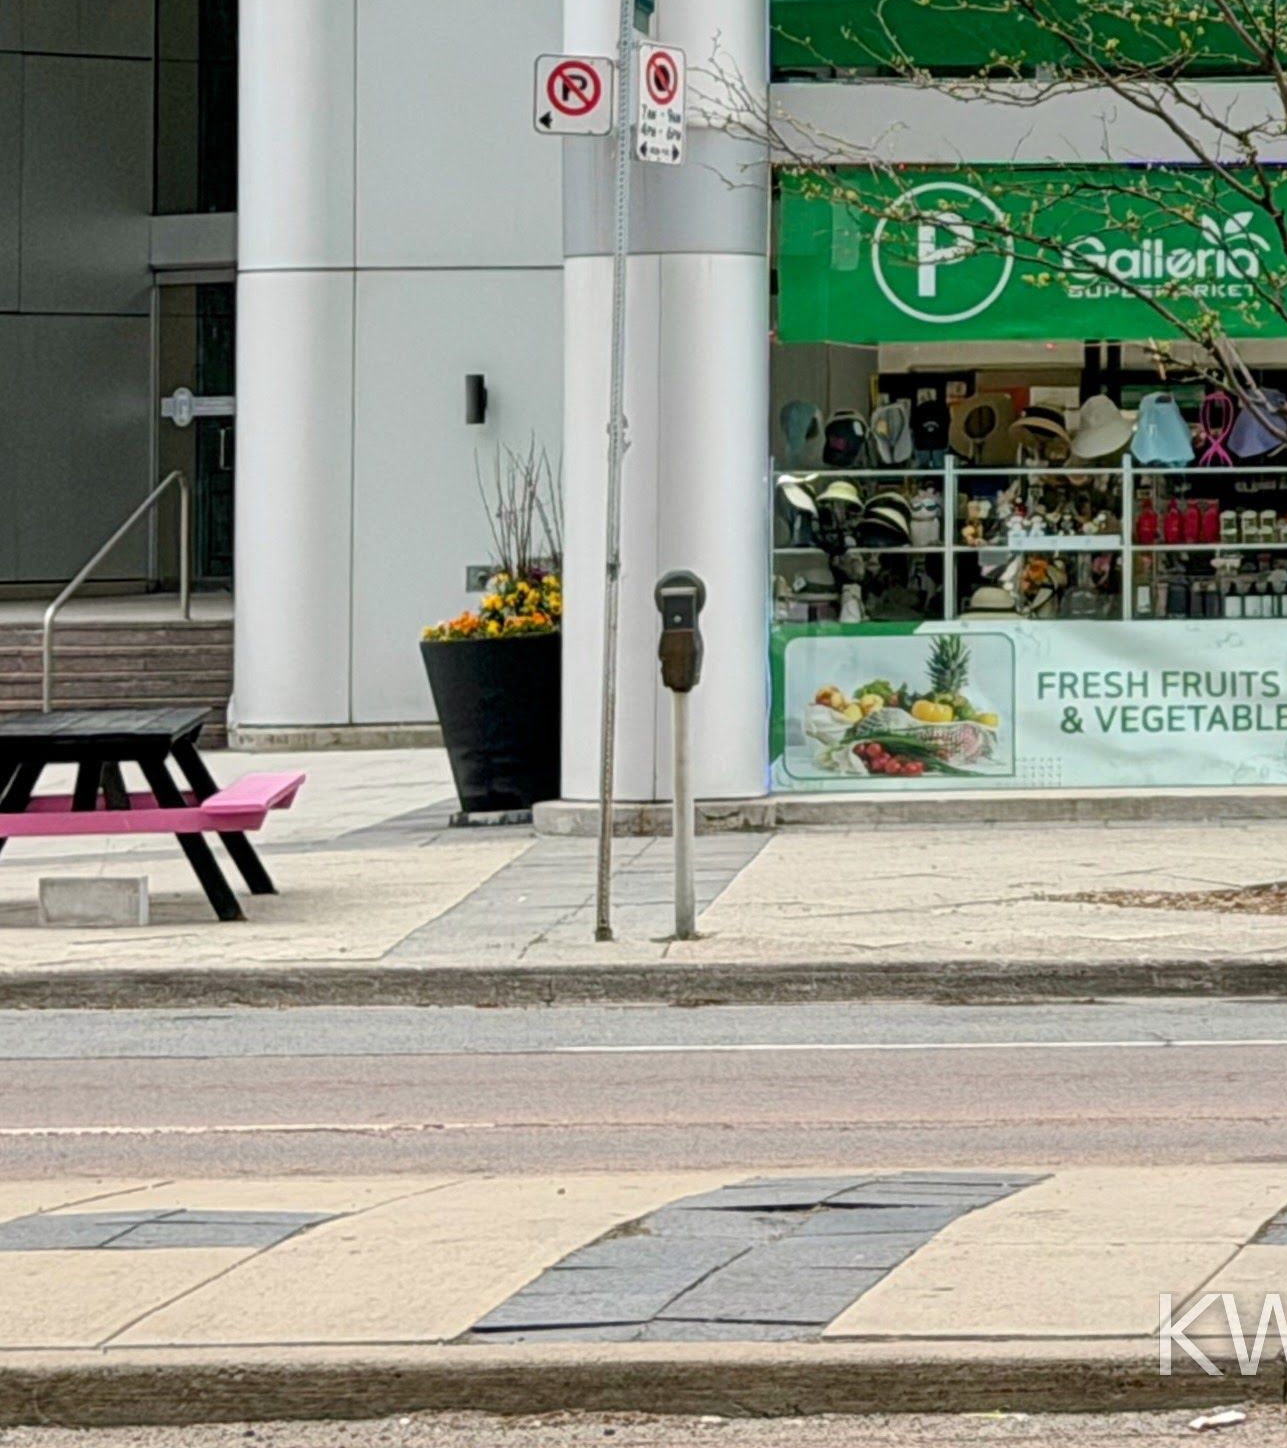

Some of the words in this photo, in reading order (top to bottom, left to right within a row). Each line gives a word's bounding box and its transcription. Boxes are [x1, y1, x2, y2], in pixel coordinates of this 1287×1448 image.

[1062, 235, 1261, 281] Galleria
[1036, 671, 1150, 700] FRESH
[1161, 670, 1281, 699] FRUITS
[1060, 707, 1085, 734] &
